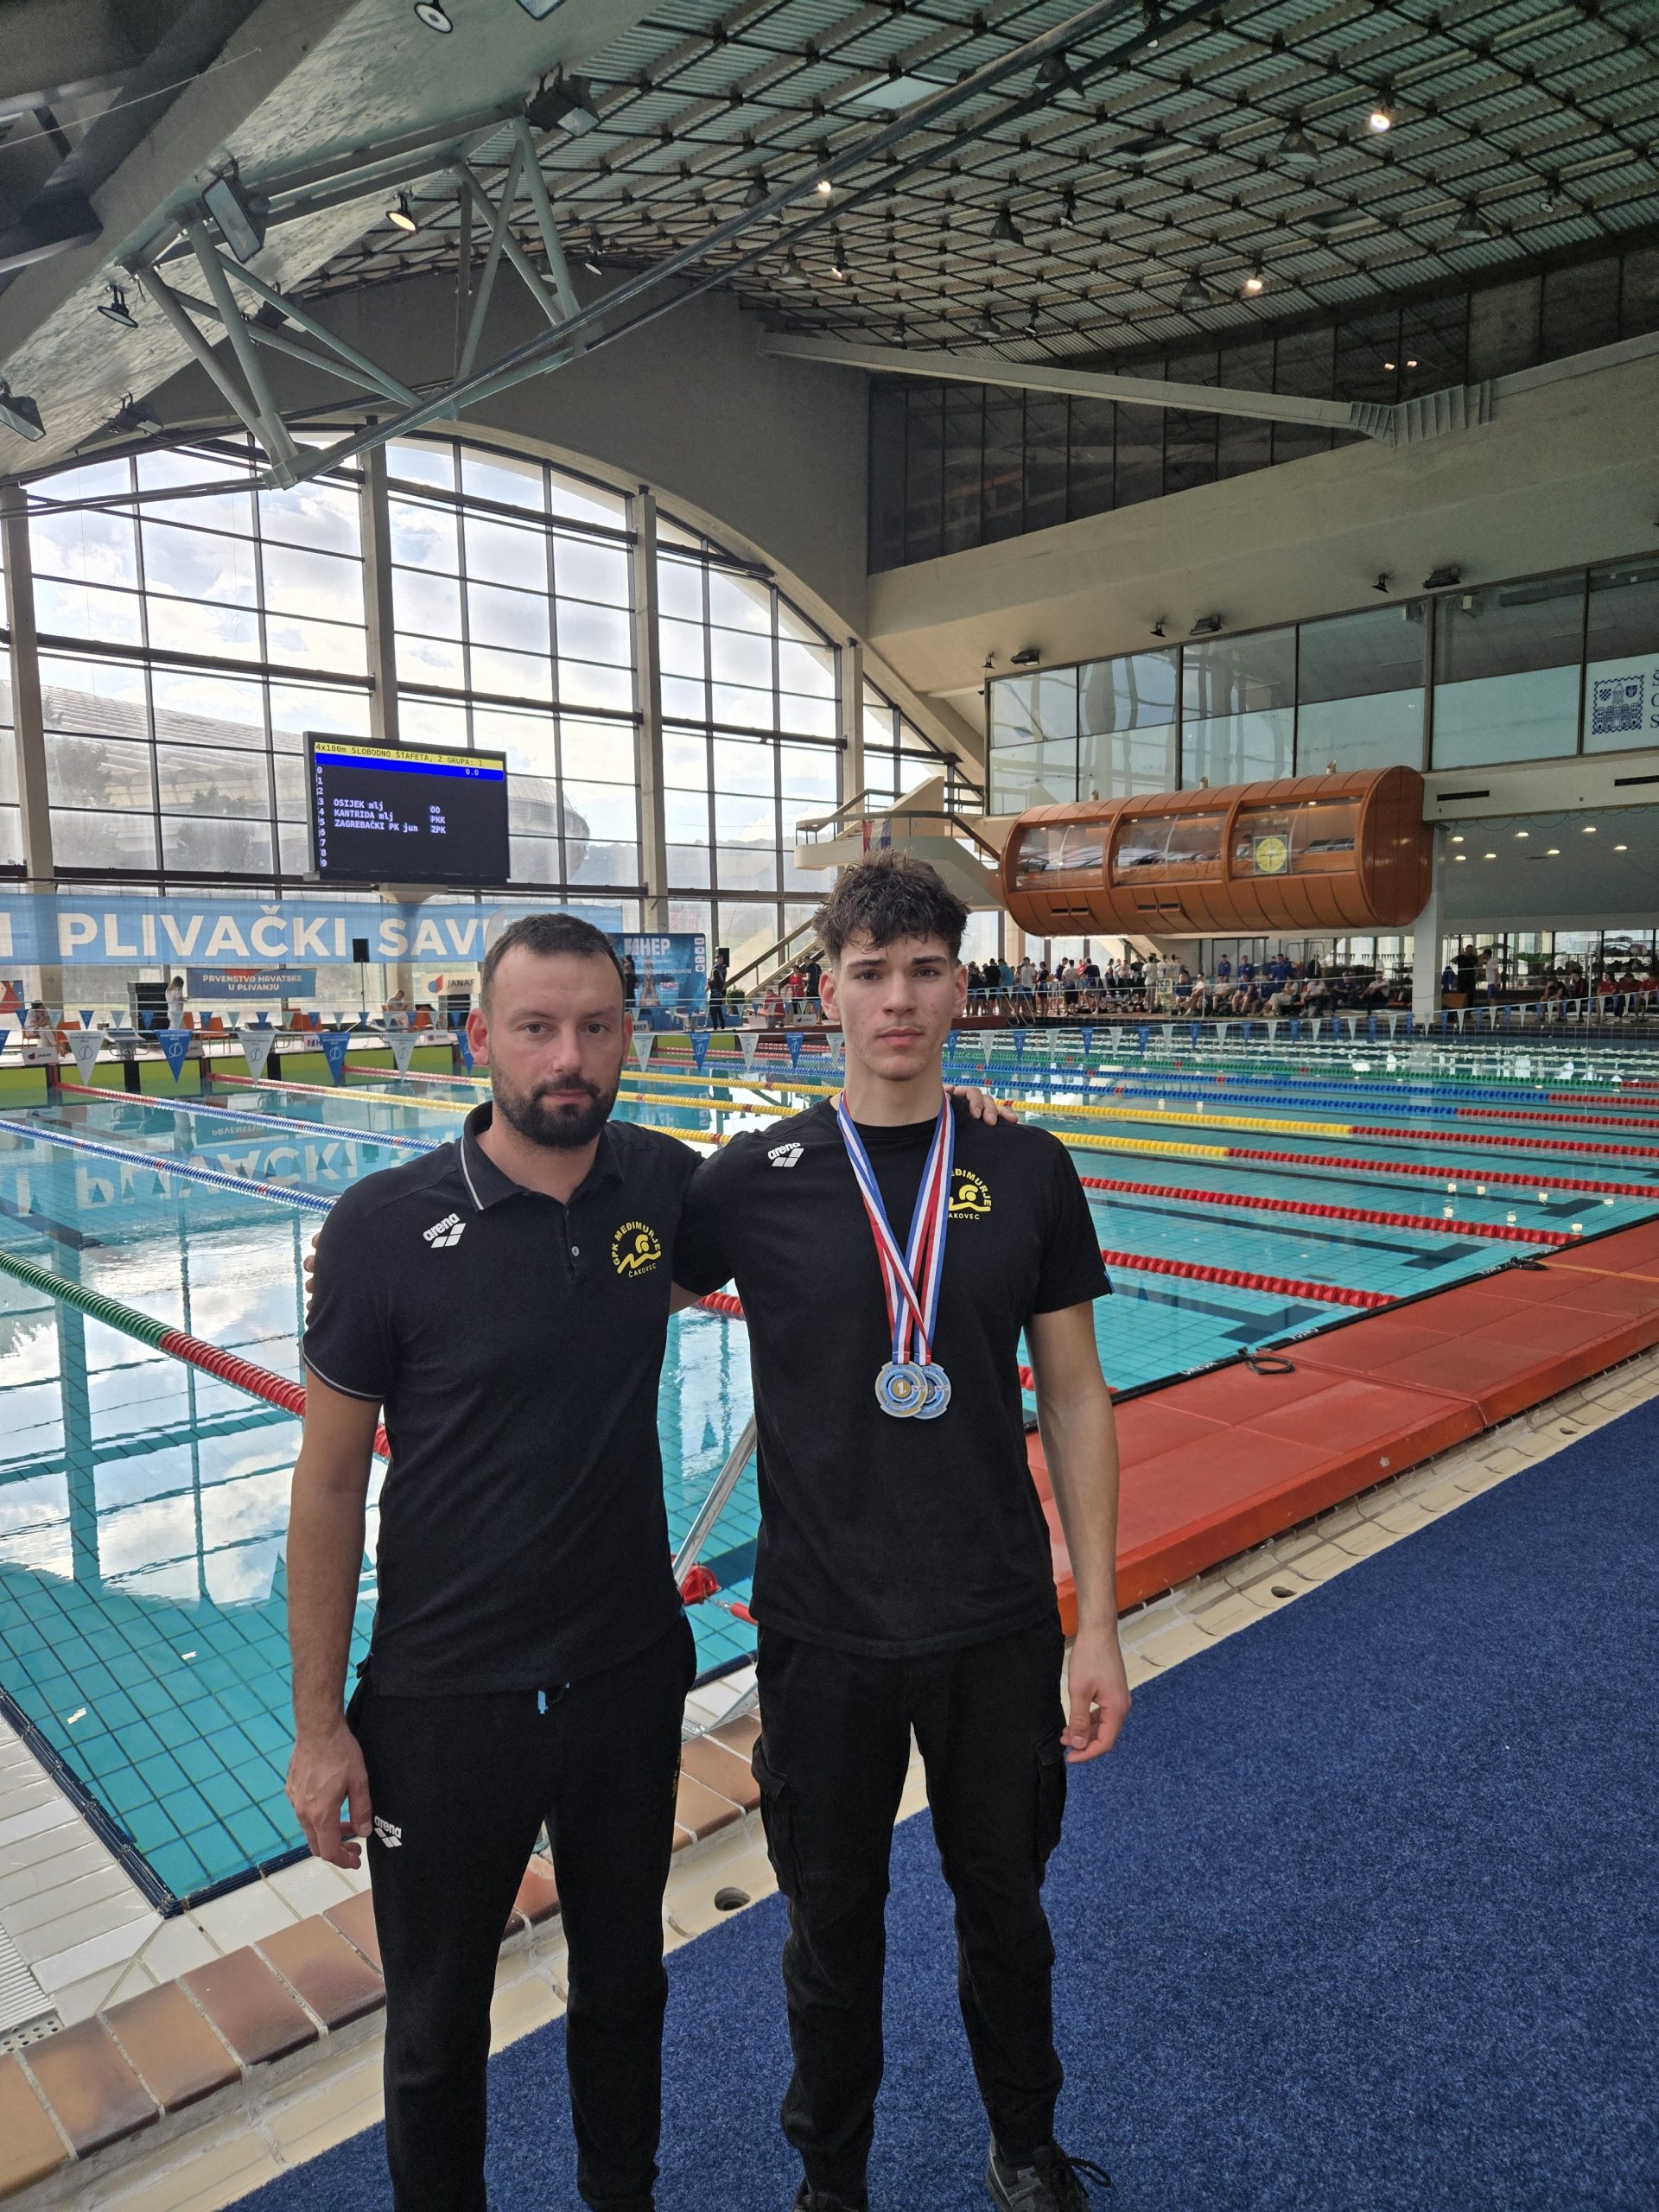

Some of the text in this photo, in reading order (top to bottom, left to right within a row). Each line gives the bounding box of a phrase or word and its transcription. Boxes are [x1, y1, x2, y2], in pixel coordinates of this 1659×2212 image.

[315, 744, 346, 753] 4x100m
[351, 747, 391, 759] SLOBODNO
[447, 757, 474, 766] GRUPA:
[334, 798, 365, 809] OSIJEK
[368, 801, 384, 811] mlj
[319, 807, 446, 824] 4 KANTRIDA mlj PKK
[334, 819, 385, 830] ZAGREBAČKI
[389, 823, 400, 831] PK
[403, 823, 418, 833] jun
[430, 825, 446, 834] ZPK
[320, 838, 327, 847] 7
[321, 849, 327, 857] 8
[321, 859, 327, 868] 9
[57, 905, 346, 957] PLIVAČKI
[202, 975, 256, 983] PRVENSTVO
[447, 979, 475, 988] JANAF
[767, 1142, 801, 1160] arena
[423, 1212, 461, 1242] arena
[611, 1243, 620, 1266] GPK
[628, 1262, 657, 1278] ČAKOVEC
[374, 1815, 402, 1839] arena
